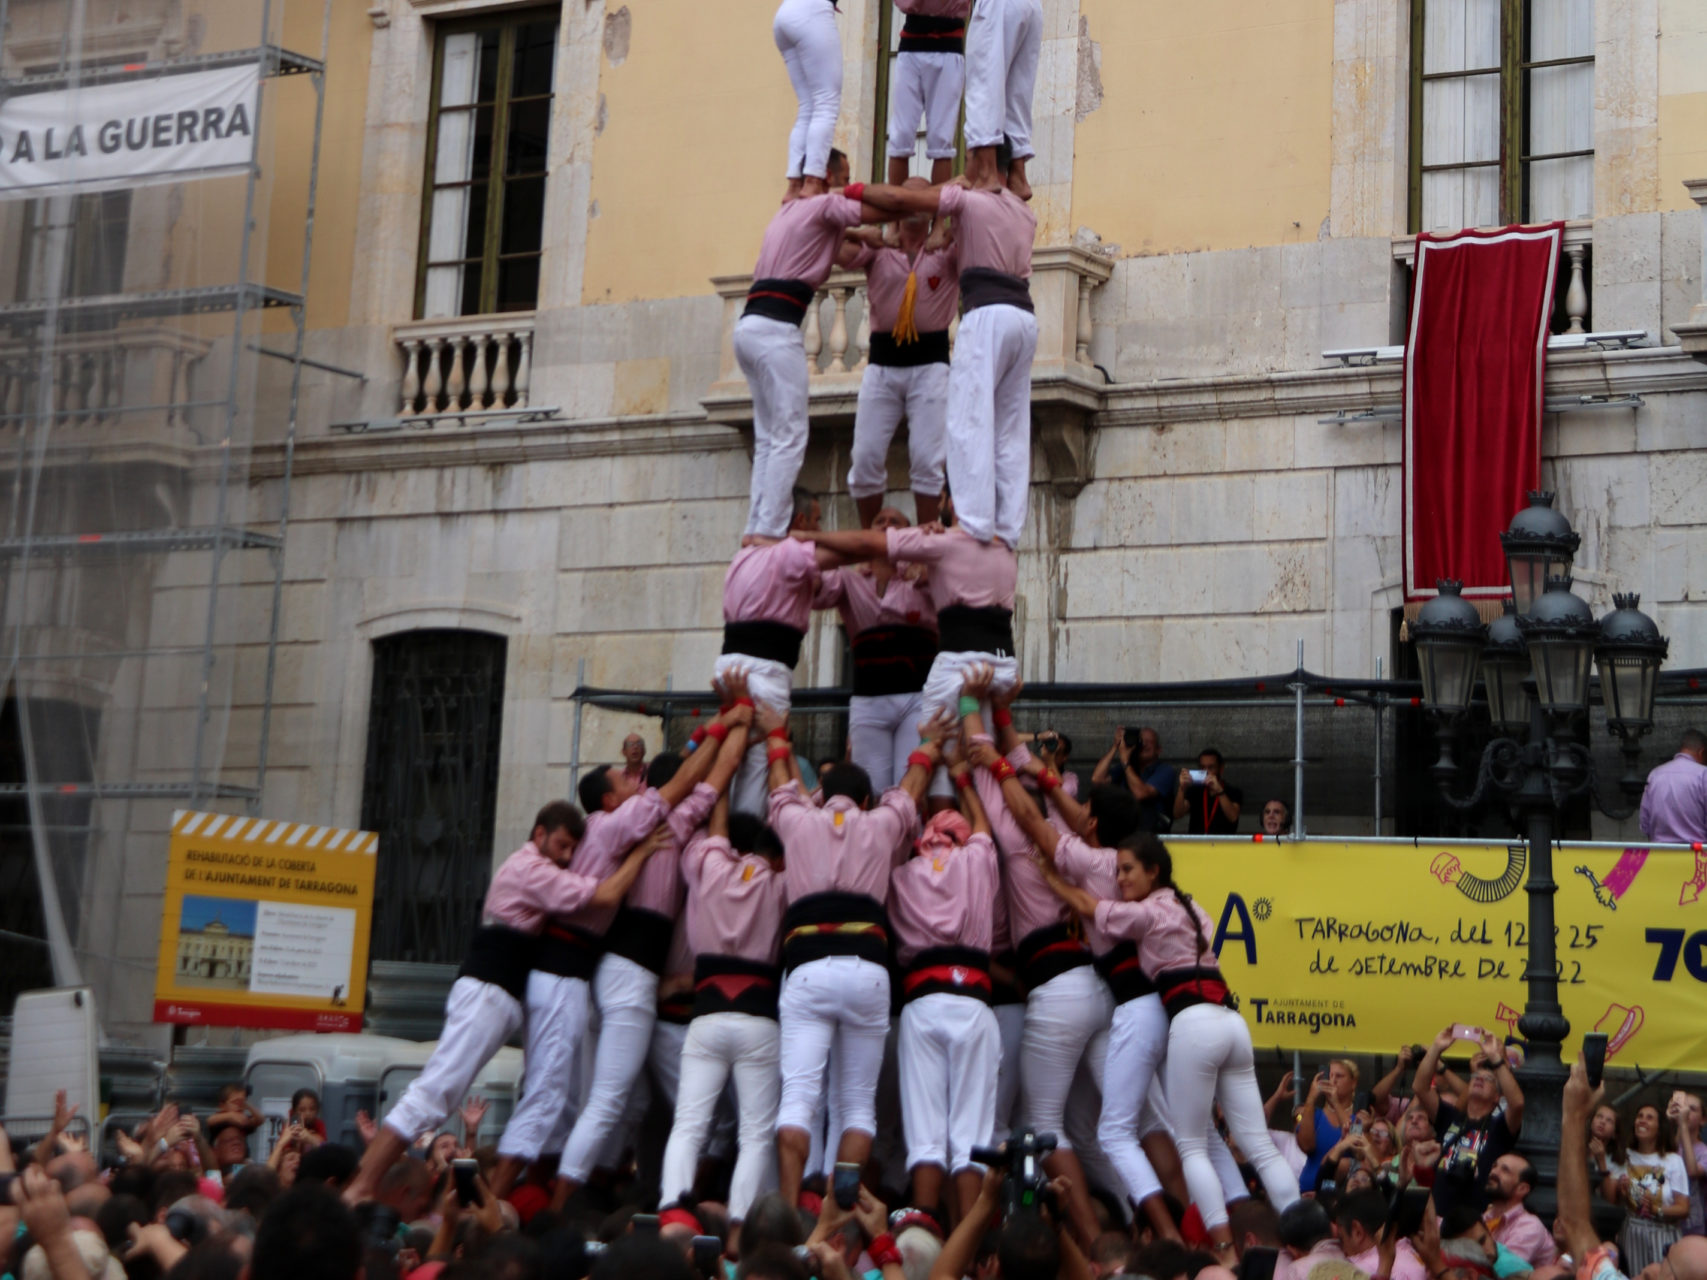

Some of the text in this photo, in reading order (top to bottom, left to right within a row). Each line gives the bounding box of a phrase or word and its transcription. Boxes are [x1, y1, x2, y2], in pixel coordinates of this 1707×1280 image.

[10, 130, 36, 164] A
[44, 124, 88, 161] LA
[98, 103, 251, 154] GUERRA
[252, 856, 265, 868] DE
[266, 857, 276, 869] LA
[278, 858, 317, 873] COBERTA
[184, 869, 197, 881] DE
[279, 878, 291, 890] DE
[294, 880, 359, 897] TARRAGONA
[1504, 919, 1529, 949] 12
[1569, 923, 1605, 950] 25
[1309, 948, 1340, 975] de
[1518, 958, 1586, 984] 222
[1273, 999, 1345, 1009] AJUNTAMENT DE
